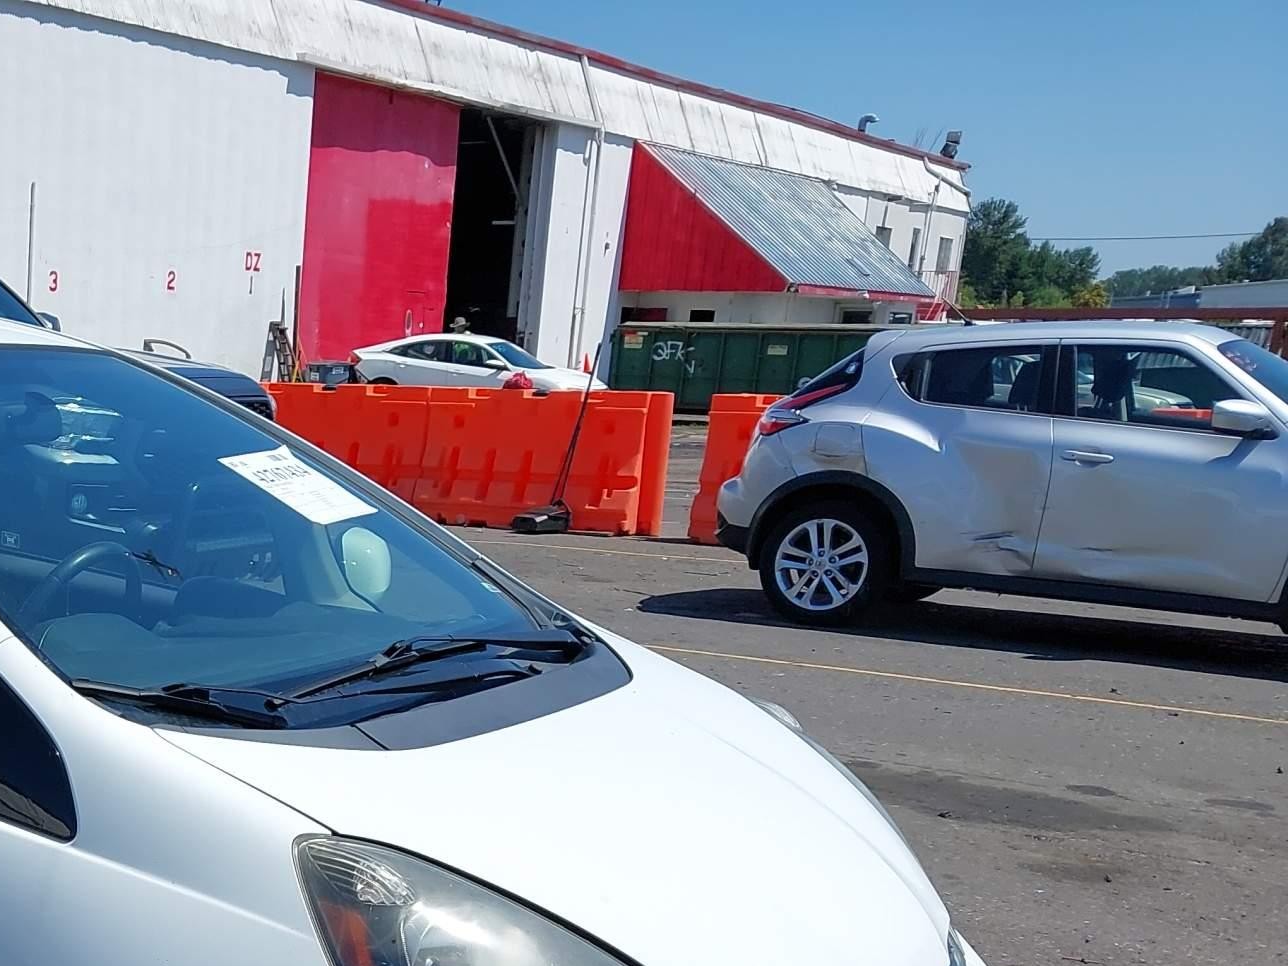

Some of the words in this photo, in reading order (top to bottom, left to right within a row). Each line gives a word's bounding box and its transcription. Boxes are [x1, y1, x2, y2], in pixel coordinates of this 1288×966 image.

[245, 252, 261, 272] DZ
[49, 270, 59, 292] 3
[166, 270, 176, 291] 2
